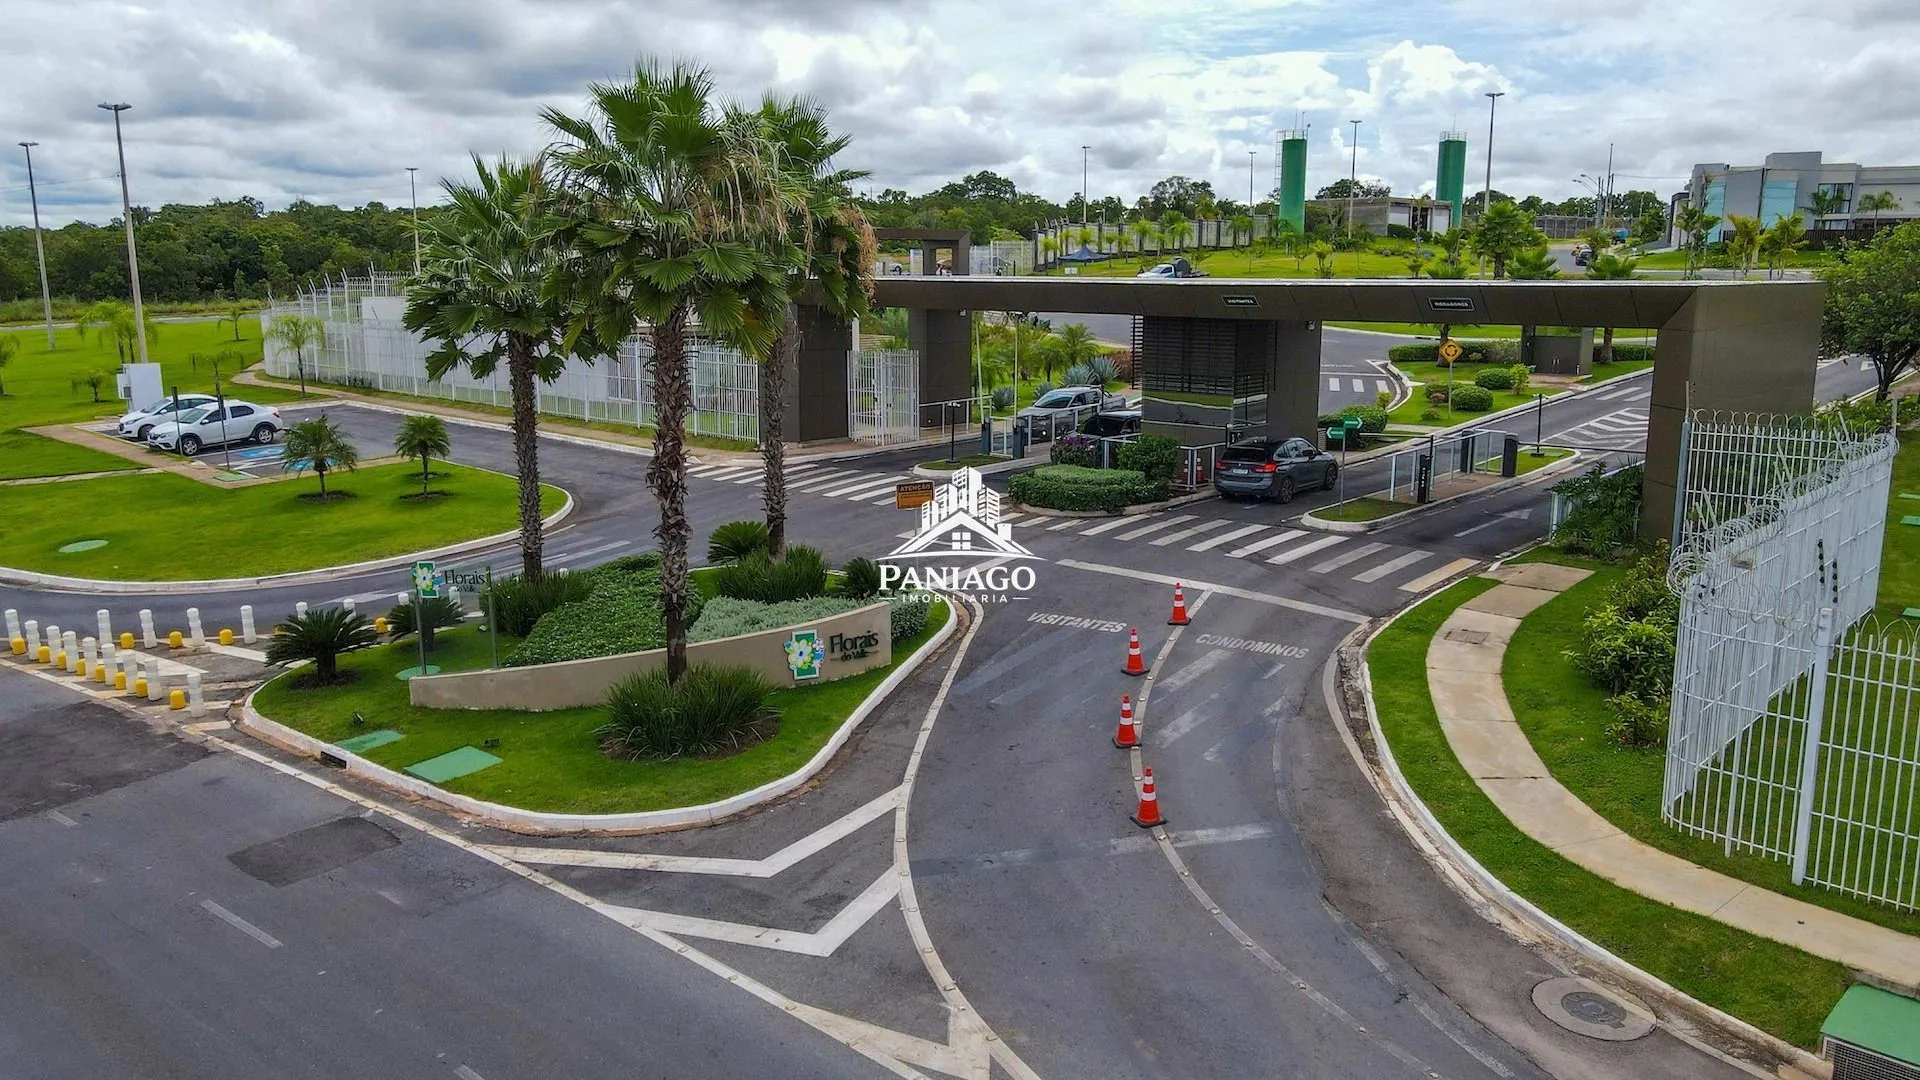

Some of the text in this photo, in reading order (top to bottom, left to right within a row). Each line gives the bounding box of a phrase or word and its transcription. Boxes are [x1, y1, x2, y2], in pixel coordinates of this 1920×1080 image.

[445, 569, 486, 585] Florais
[1027, 612, 1127, 633] VISITANTES
[830, 630, 879, 653] Florais
